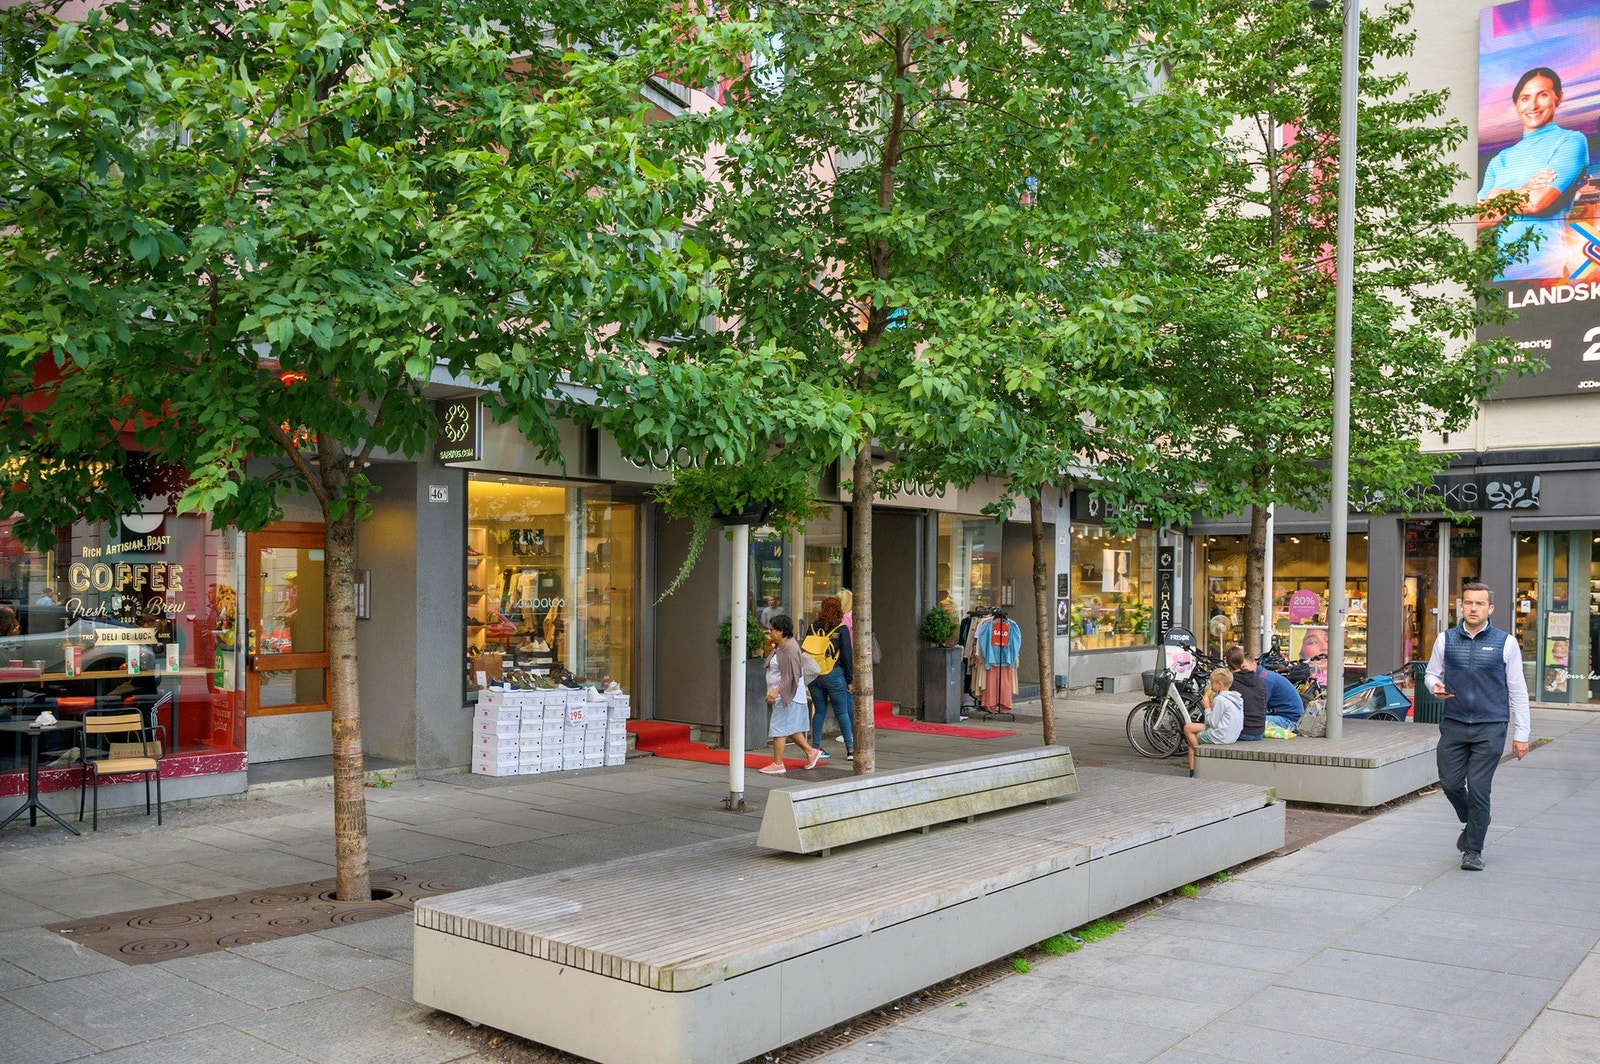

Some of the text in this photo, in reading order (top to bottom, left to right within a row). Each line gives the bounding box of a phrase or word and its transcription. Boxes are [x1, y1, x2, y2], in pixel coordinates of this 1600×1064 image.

[68, 562, 184, 592] COFFEE
[65, 596, 185, 618] Fresh Brew
[1293, 596, 1315, 605] 20%
[101, 633, 118, 641] DELI
[121, 633, 130, 641] DE
[134, 632, 152, 641] LUCA
